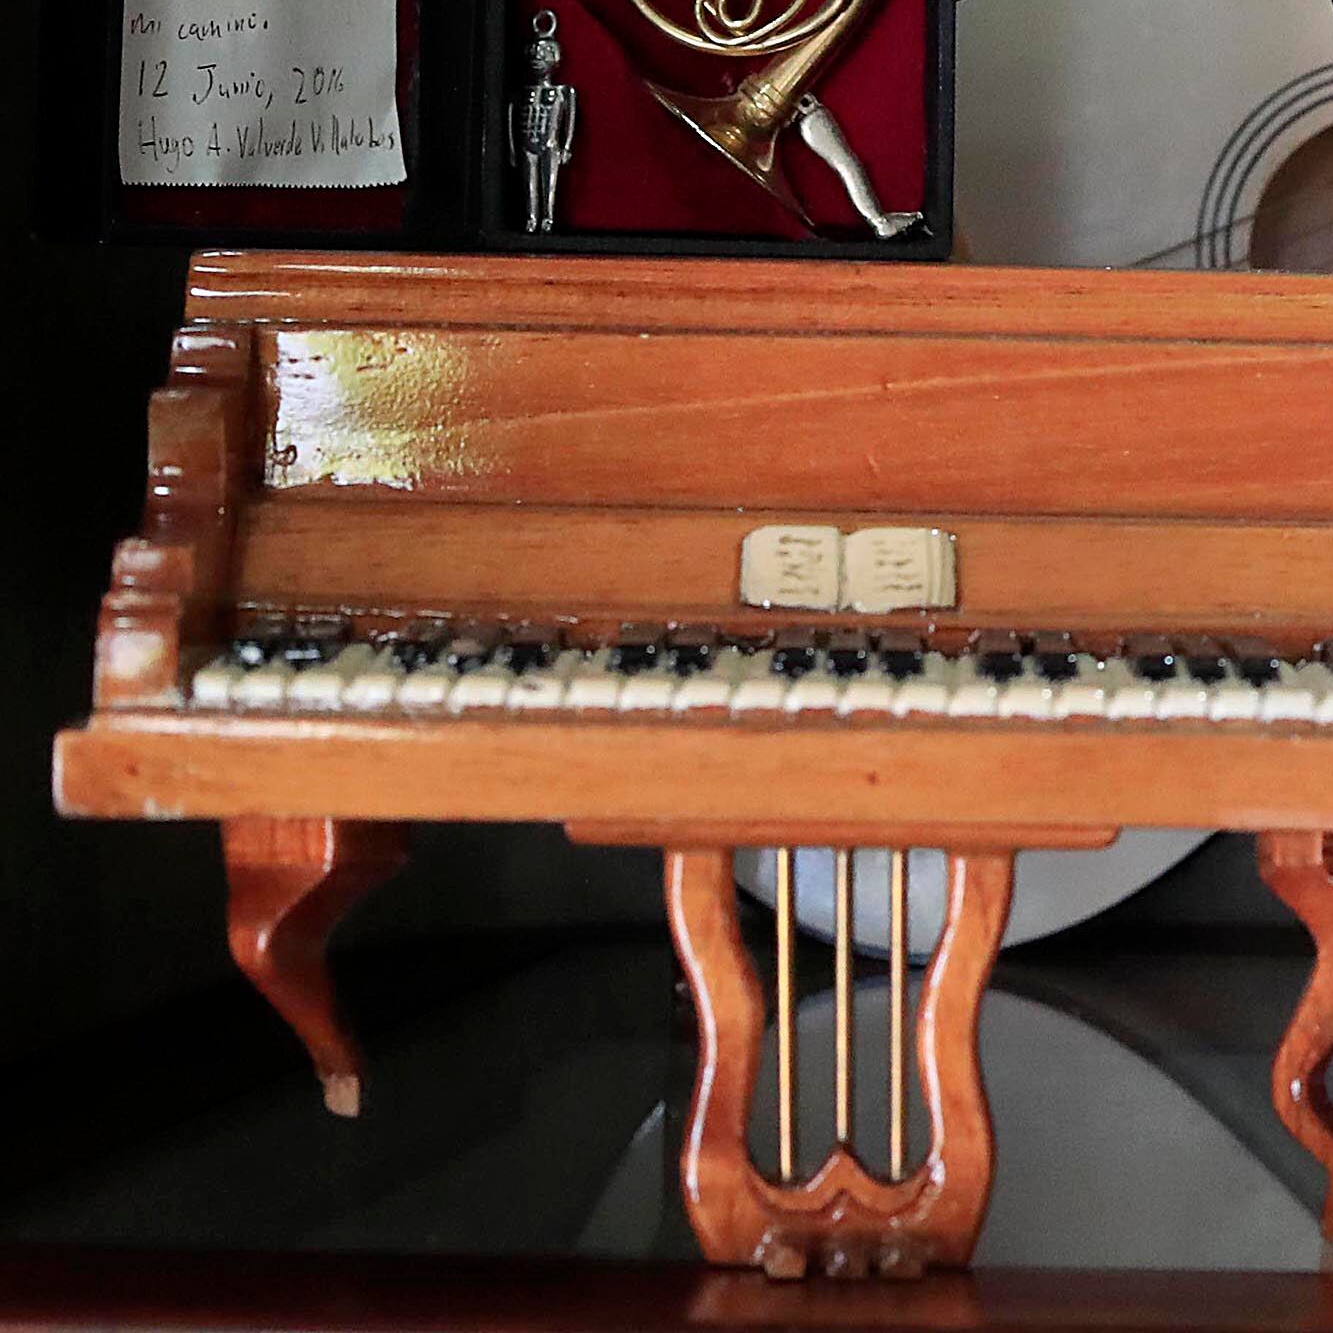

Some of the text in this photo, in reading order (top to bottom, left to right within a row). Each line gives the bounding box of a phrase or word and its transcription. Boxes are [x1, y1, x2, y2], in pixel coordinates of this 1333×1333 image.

[178, 12, 269, 42] camino.
[138, 60, 345, 109] 12 Junio, 2016
[138, 116, 194, 174] Hugo
[206, 122, 232, 155] A.
[237, 117, 303, 159] Valverde
